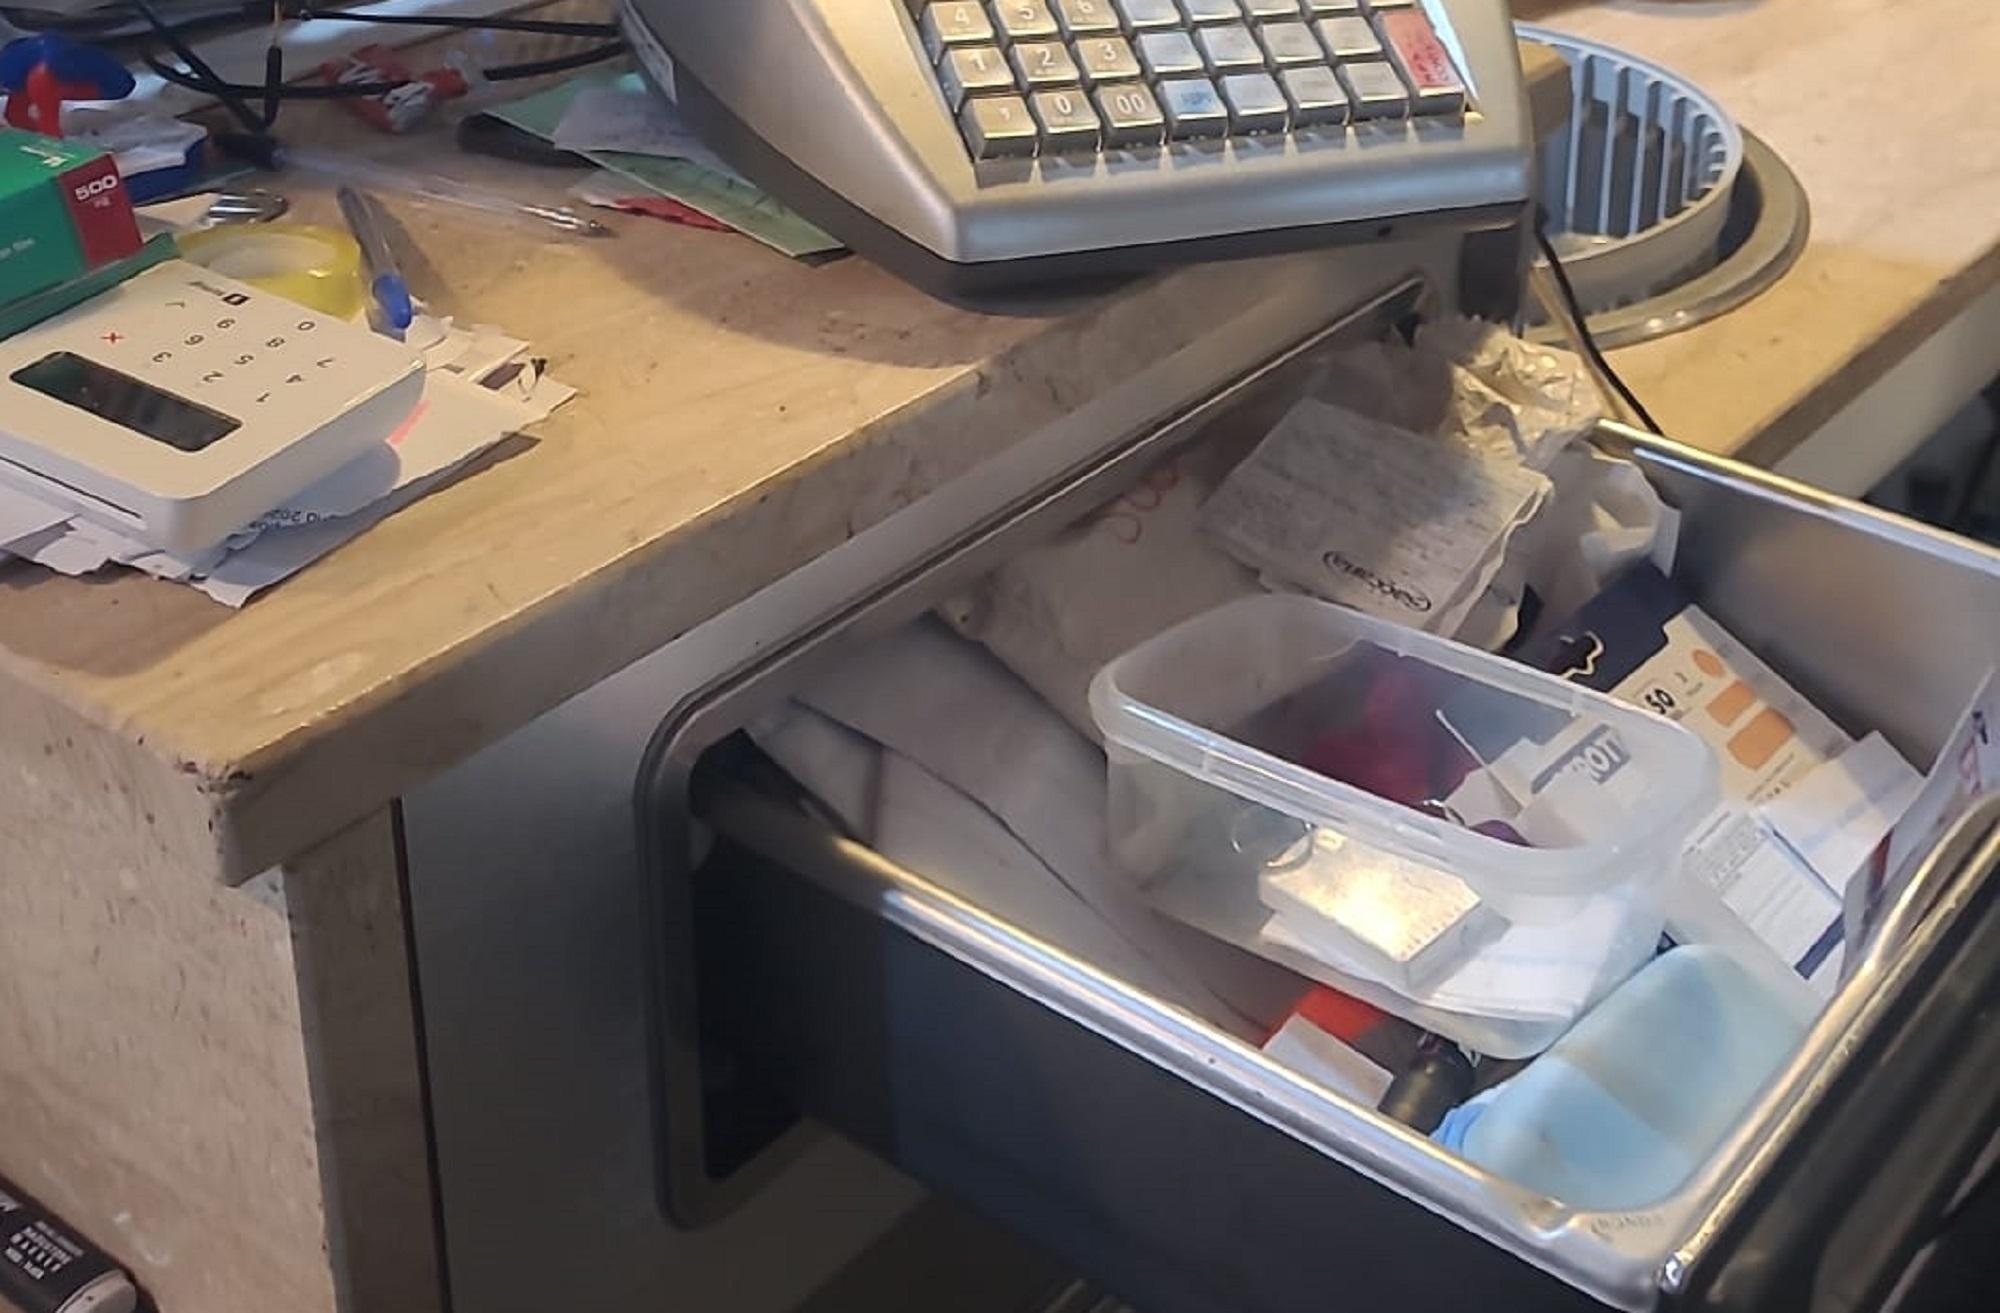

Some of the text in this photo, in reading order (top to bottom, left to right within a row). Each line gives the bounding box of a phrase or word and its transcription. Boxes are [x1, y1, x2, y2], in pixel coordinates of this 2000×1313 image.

[955, 8, 969, 22] 4
[970, 44, 1115, 71] 1 2 3
[1056, 96, 1071, 114] 0
[1116, 93, 1145, 114] 00
[75, 175, 118, 201] 500
[298, 320, 316, 332] 0
[265, 336, 286, 349] 8
[316, 357, 336, 369] 7
[152, 351, 271, 403] 3 2 1
[233, 354, 254, 366] 5
[285, 373, 304, 385] 4
[1645, 688, 1677, 715] 50
